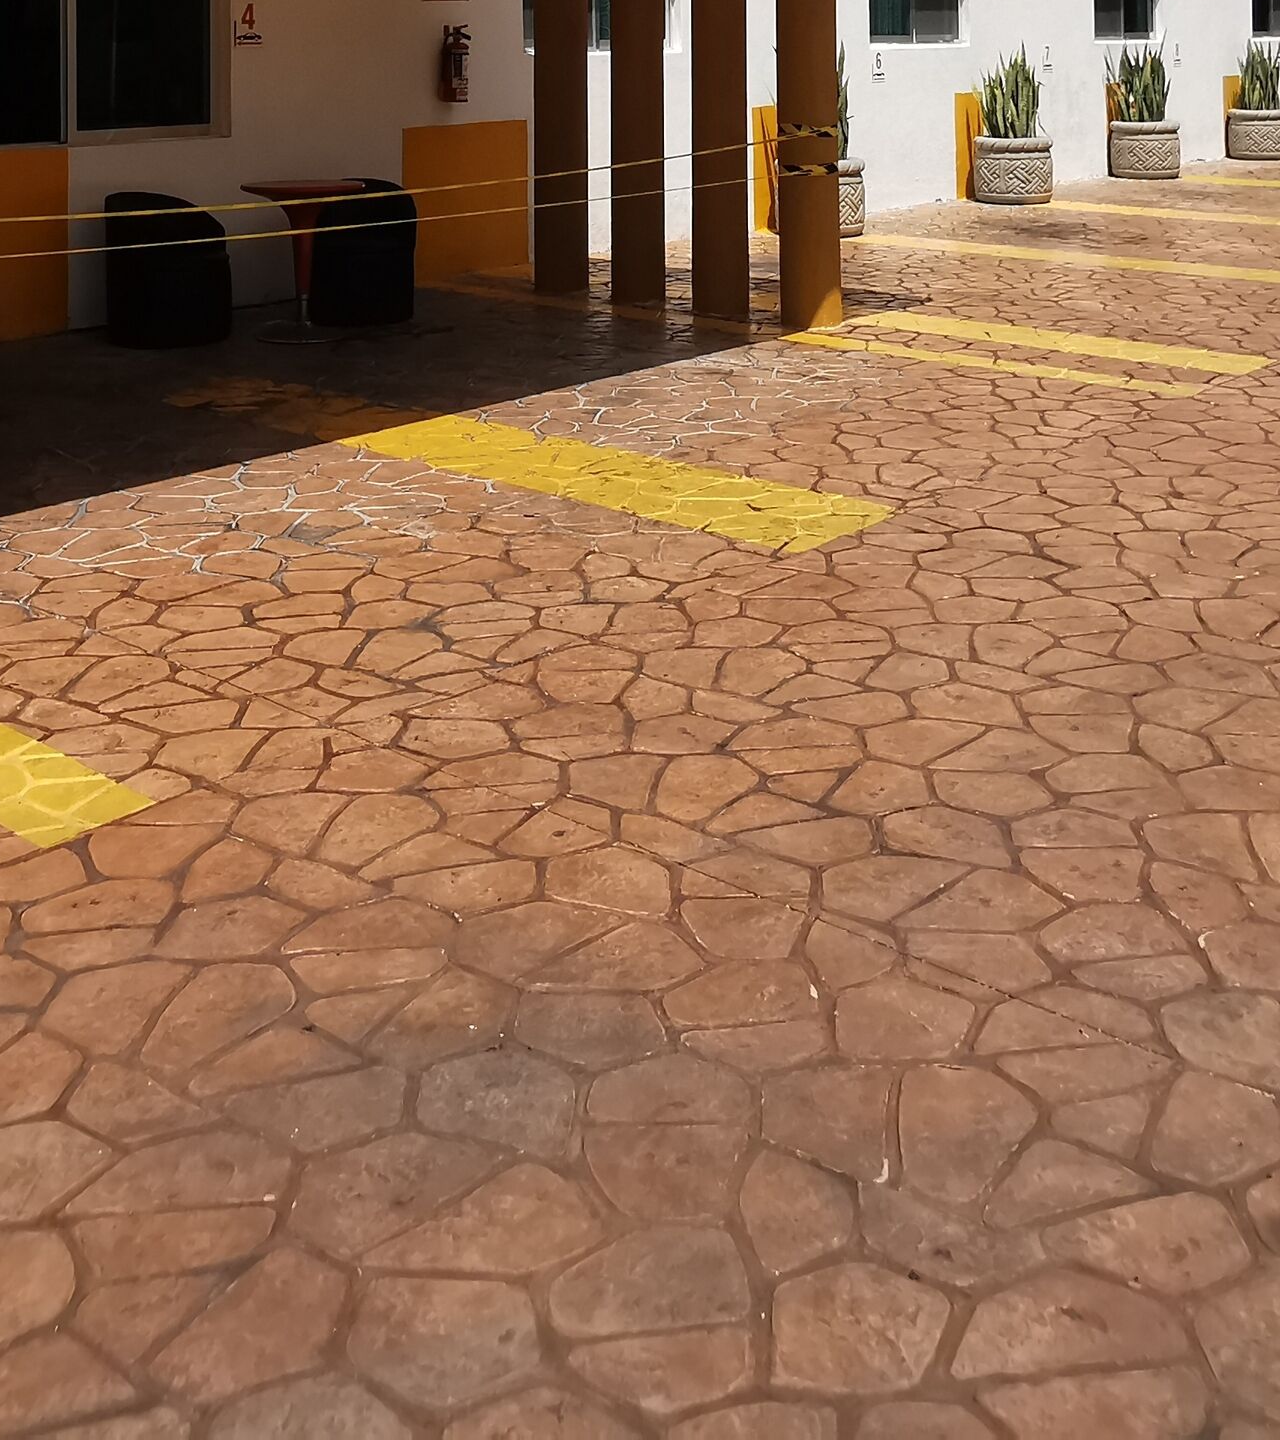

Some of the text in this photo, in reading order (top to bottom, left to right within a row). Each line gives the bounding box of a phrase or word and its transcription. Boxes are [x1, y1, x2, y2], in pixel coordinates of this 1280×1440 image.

[241, 3, 256, 30] 4
[876, 52, 882, 69] 6
[1045, 46, 1050, 61] 7
